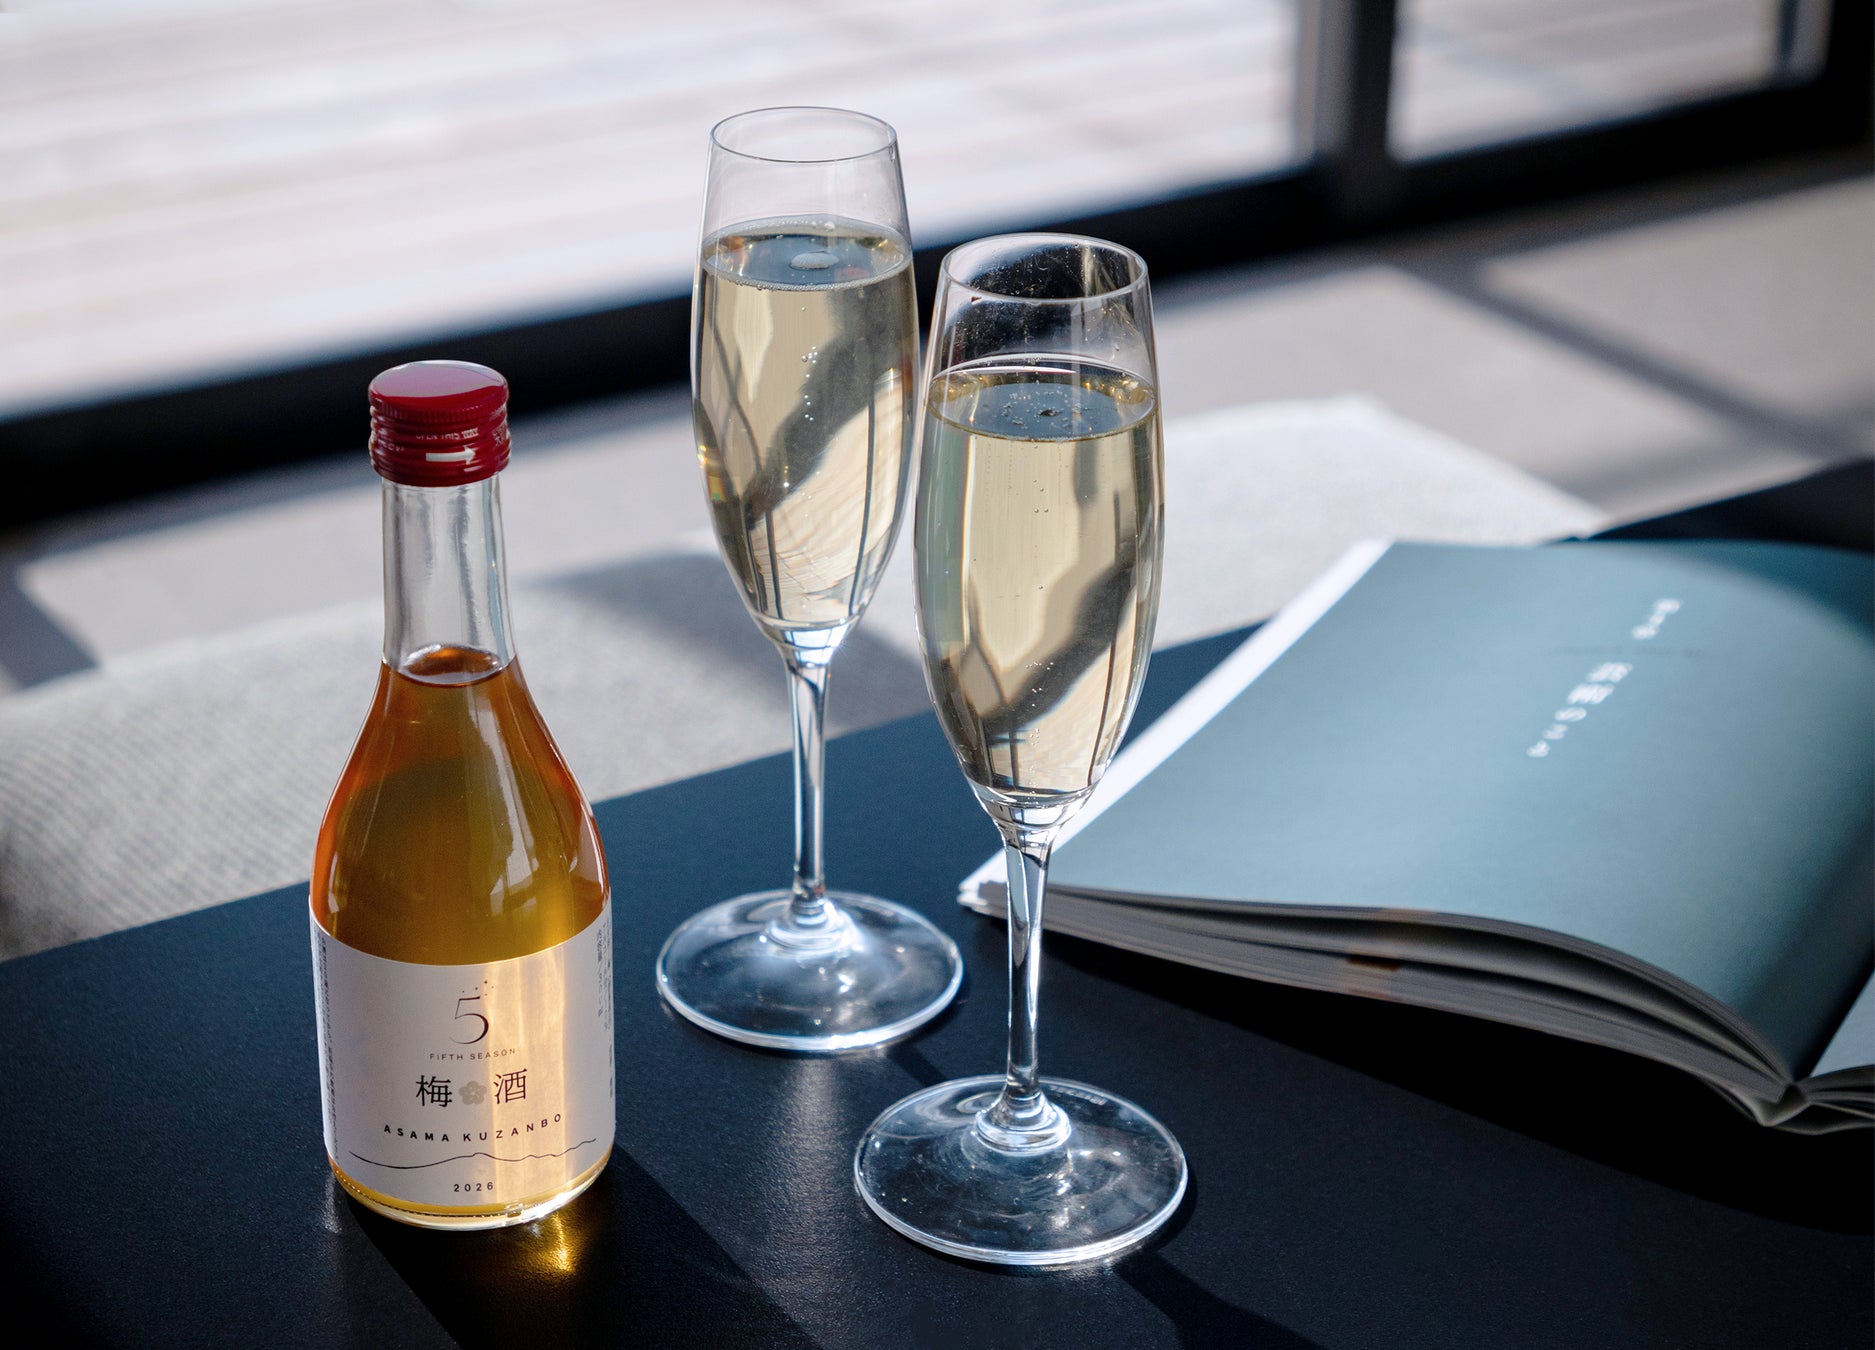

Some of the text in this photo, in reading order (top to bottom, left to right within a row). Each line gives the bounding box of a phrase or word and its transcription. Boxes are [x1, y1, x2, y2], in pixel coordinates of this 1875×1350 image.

[450, 995, 490, 1045] 5
[429, 1048, 516, 1061] FIFTH SEASON
[383, 1113, 562, 1142] ASAMA KUZANBO
[453, 1181, 494, 1193] 2026
